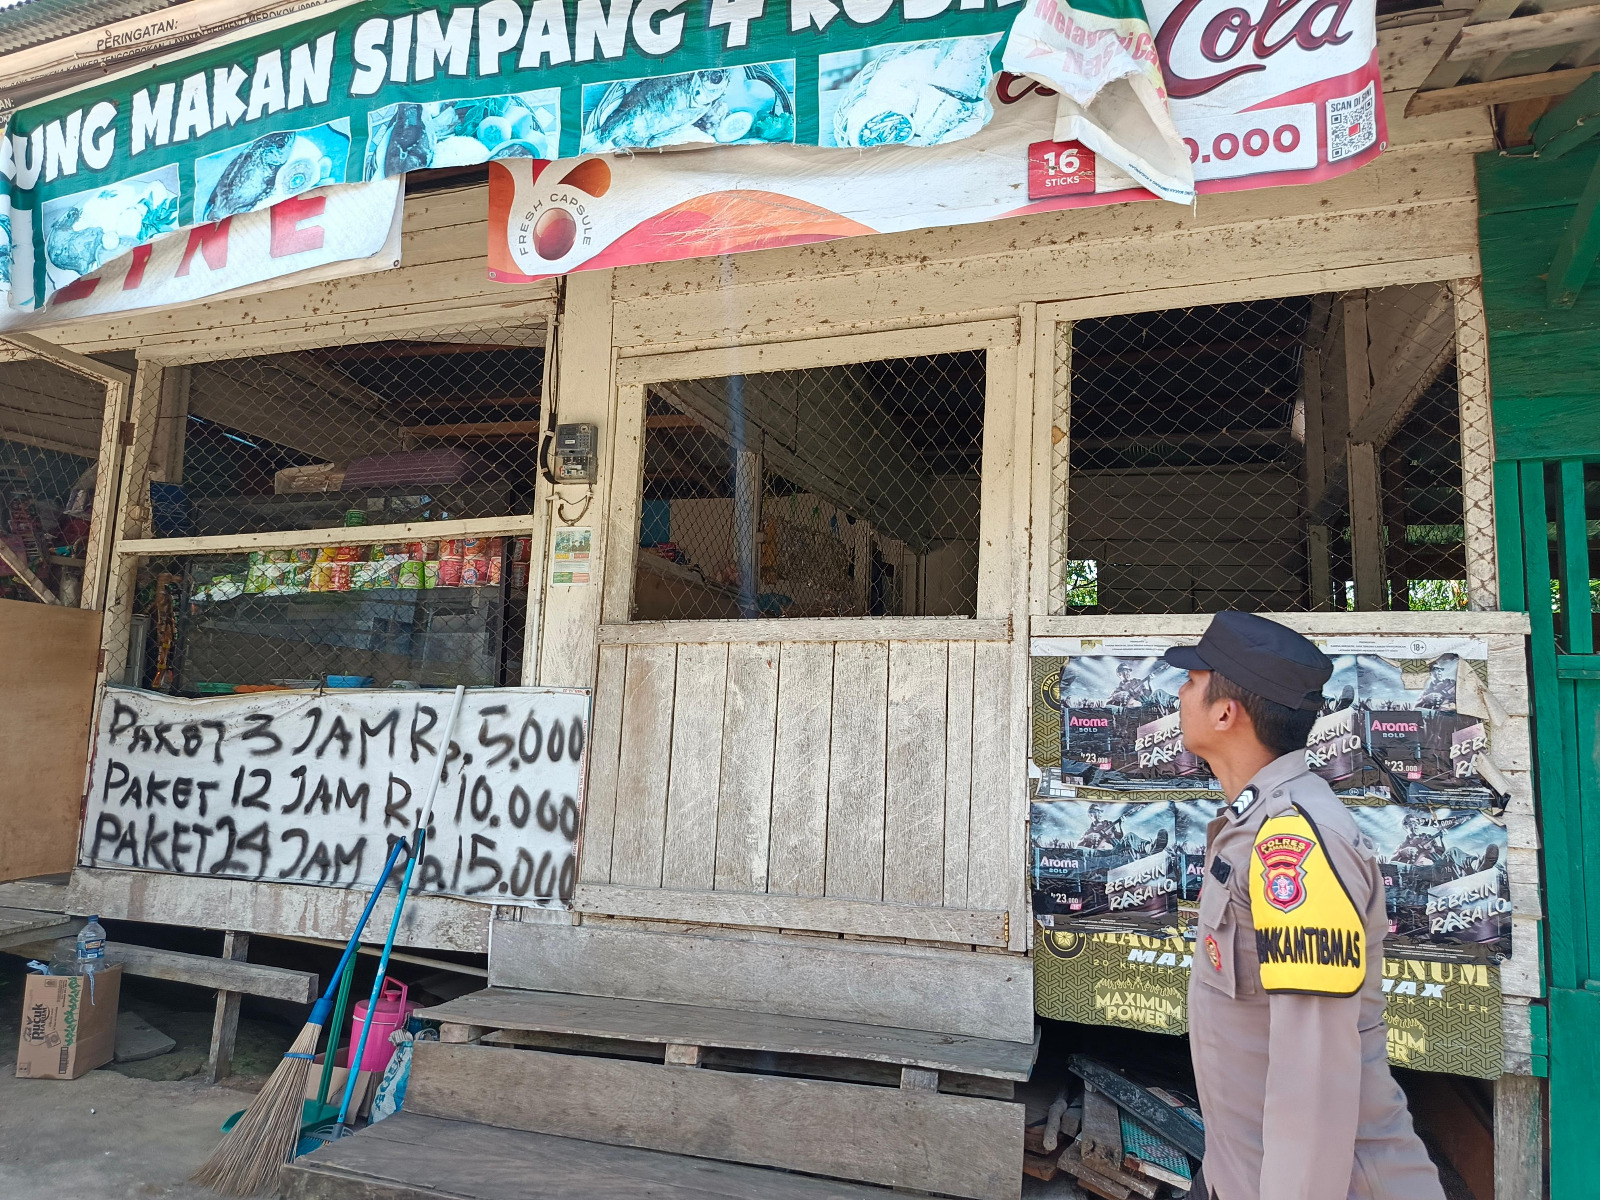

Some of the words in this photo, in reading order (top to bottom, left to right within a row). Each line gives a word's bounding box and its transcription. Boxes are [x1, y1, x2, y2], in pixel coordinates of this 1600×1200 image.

[97, 18, 179, 51] PERINGATAN:
[131, 32, 336, 157] MAKAN
[351, 0, 687, 96] SIMPANG
[1331, 100, 1352, 113] SCAN
[1354, 96, 1361, 108] DI
[1044, 148, 1080, 175] 16
[1045, 174, 1080, 188] STICKS
[519, 200, 543, 256] FRESH
[550, 193, 593, 246] CAPSULE
[1070, 716, 1108, 727] Aroma
[1371, 719, 1418, 732] Aroma
[242, 713, 283, 756] 3
[293, 706, 400, 768] JAM
[1341, 735, 1362, 756] LO
[103, 757, 220, 817] PAKET
[231, 765, 272, 812] 12
[281, 764, 369, 823] JAM
[91, 811, 214, 873] PAKET
[210, 815, 271, 881] 24
[279, 827, 368, 888] JAM
[1260, 838, 1306, 852] POLRES
[1040, 856, 1079, 869] Aroma
[1105, 863, 1166, 895] BEBASIN
[1157, 878, 1174, 896] LO
[1425, 882, 1497, 916] BEBASIN
[1487, 898, 1508, 917] LO
[1094, 959, 1109, 967] 20
[1120, 963, 1174, 975] KRETEK
[1096, 991, 1182, 1020] MAXIMUM
[1428, 999, 1489, 1014] FILTER
[1106, 1005, 1168, 1029] POWER
